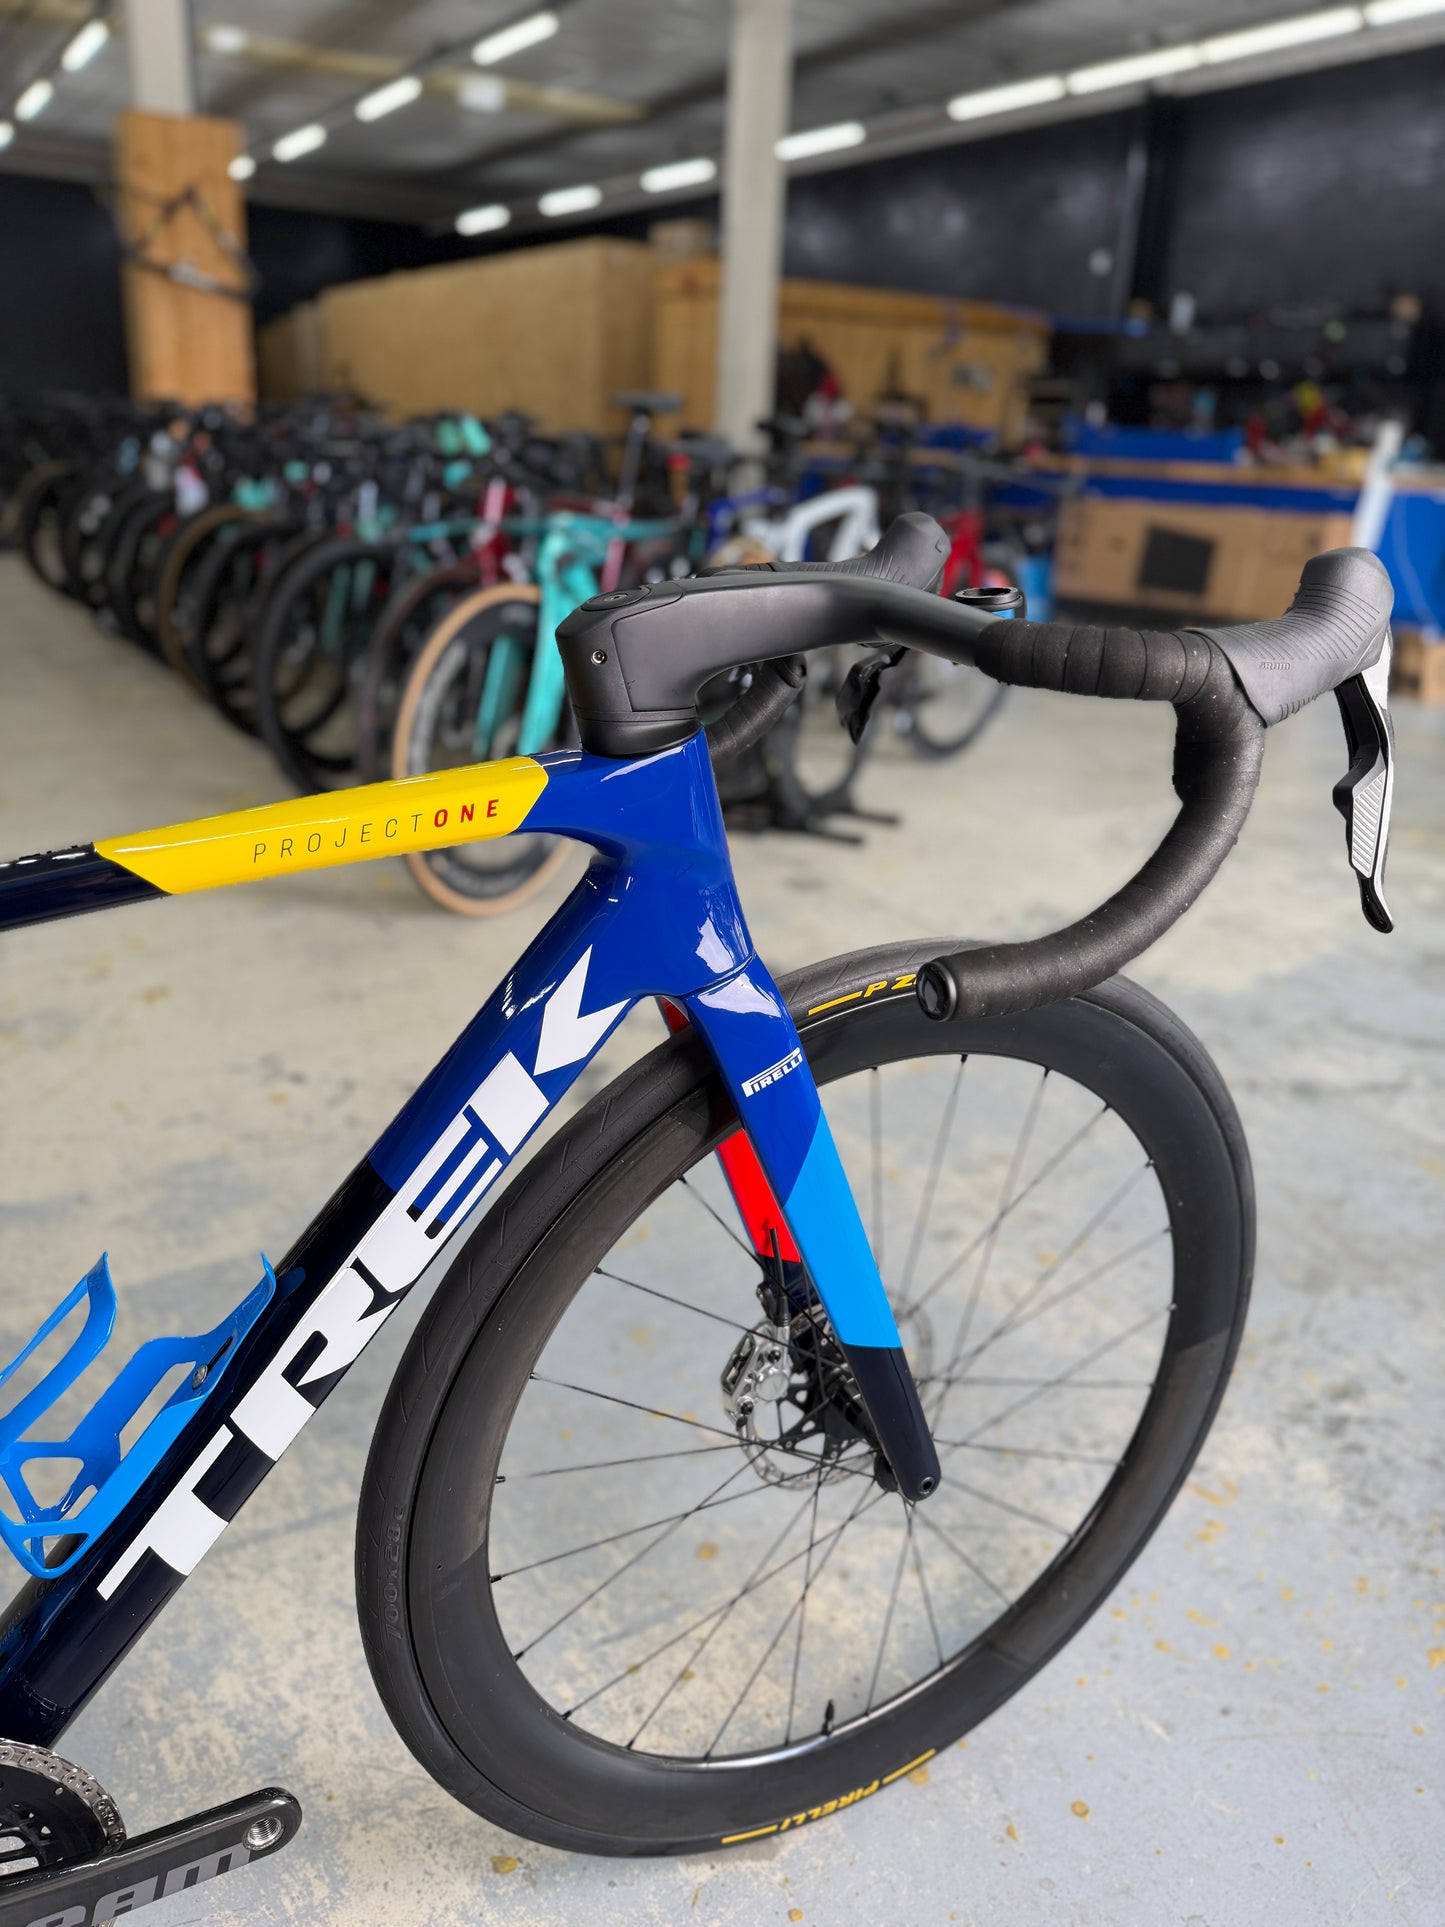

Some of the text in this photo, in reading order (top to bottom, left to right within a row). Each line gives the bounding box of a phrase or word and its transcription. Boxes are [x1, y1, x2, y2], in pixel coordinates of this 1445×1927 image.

[891, 973, 917, 990] Z
[741, 1047, 803, 1097] PIRELLI
[97, 943, 631, 1601] TREK
[780, 1779, 880, 1831] PIRELLI
